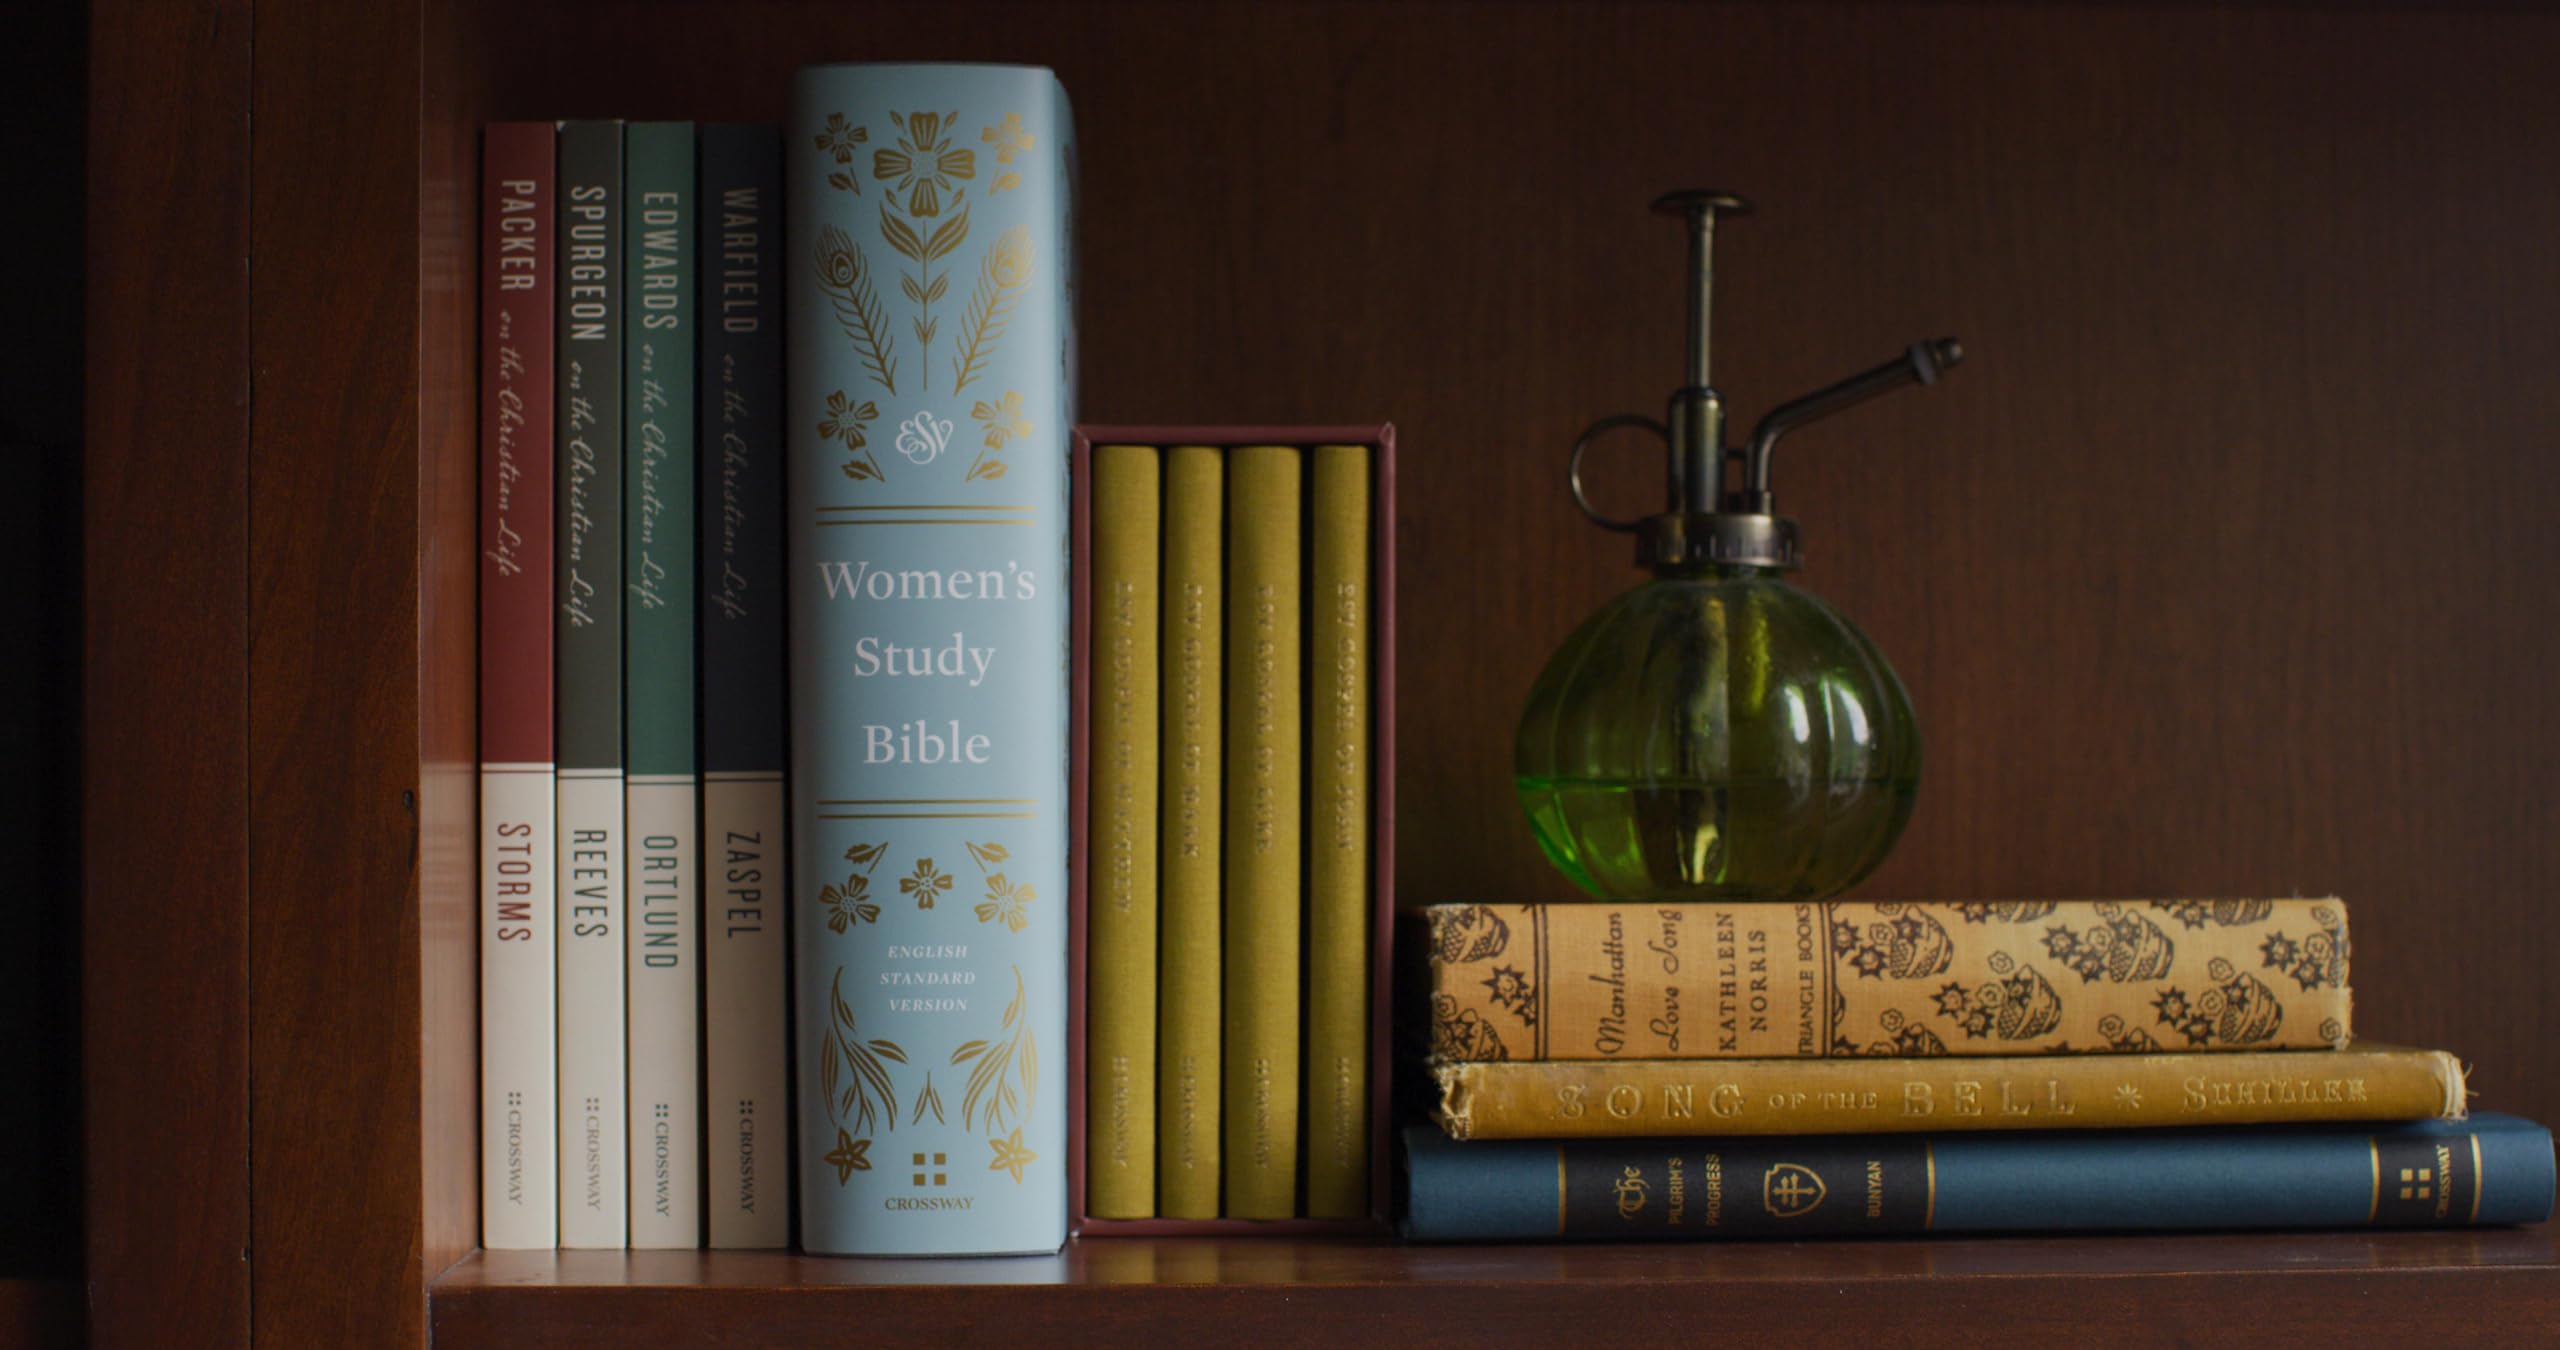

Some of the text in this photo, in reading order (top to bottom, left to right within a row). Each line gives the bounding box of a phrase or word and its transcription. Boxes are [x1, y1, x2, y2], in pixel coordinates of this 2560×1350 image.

[485, 180, 536, 577] PACKER on the Christian Life
[562, 185, 606, 628] SPURGEON on the Christian Life
[629, 191, 678, 609] EDWARDS on the Christian Life
[713, 187, 759, 620] WARFIELD on the Christian Life
[895, 411, 954, 464] ESV
[817, 560, 1036, 600] Women's
[854, 632, 996, 687] Study
[863, 719, 991, 764] Bible
[498, 823, 532, 942] STORMS
[573, 829, 607, 937] REEVES
[643, 835, 678, 968] ORTLUND
[727, 831, 761, 939] ZASPEL
[879, 972, 976, 985] STANDARD
[888, 945, 968, 959] ENGLISH
[1588, 912, 1625, 1055] Manhattan
[1648, 909, 1682, 1052] Love Song
[1716, 912, 1737, 1053] KATHLEEN
[1748, 930, 1767, 1032] NORRIS
[1795, 903, 1814, 1055] TRIANGLE BOOKS
[888, 999, 968, 1012] VERSION
[1554, 1083, 1744, 1120] SONG
[1768, 1093, 1806, 1110] OF
[1818, 1091, 1878, 1110] THE
[1902, 1080, 2077, 1118] BELL
[508, 1110, 523, 1205] CROSSWAY
[585, 1115, 600, 1211] CROSSWAY
[655, 1122, 670, 1217] CROSSWAY
[740, 1118, 754, 1214] CROSSWAY
[885, 1198, 974, 1211] CROSSWAY
[1612, 1165, 1651, 1220] The
[1668, 1157, 1684, 1225] PILGRIM'S
[1705, 1153, 1722, 1227] PROGRESS
[1867, 1160, 1883, 1217] BUNYAN
